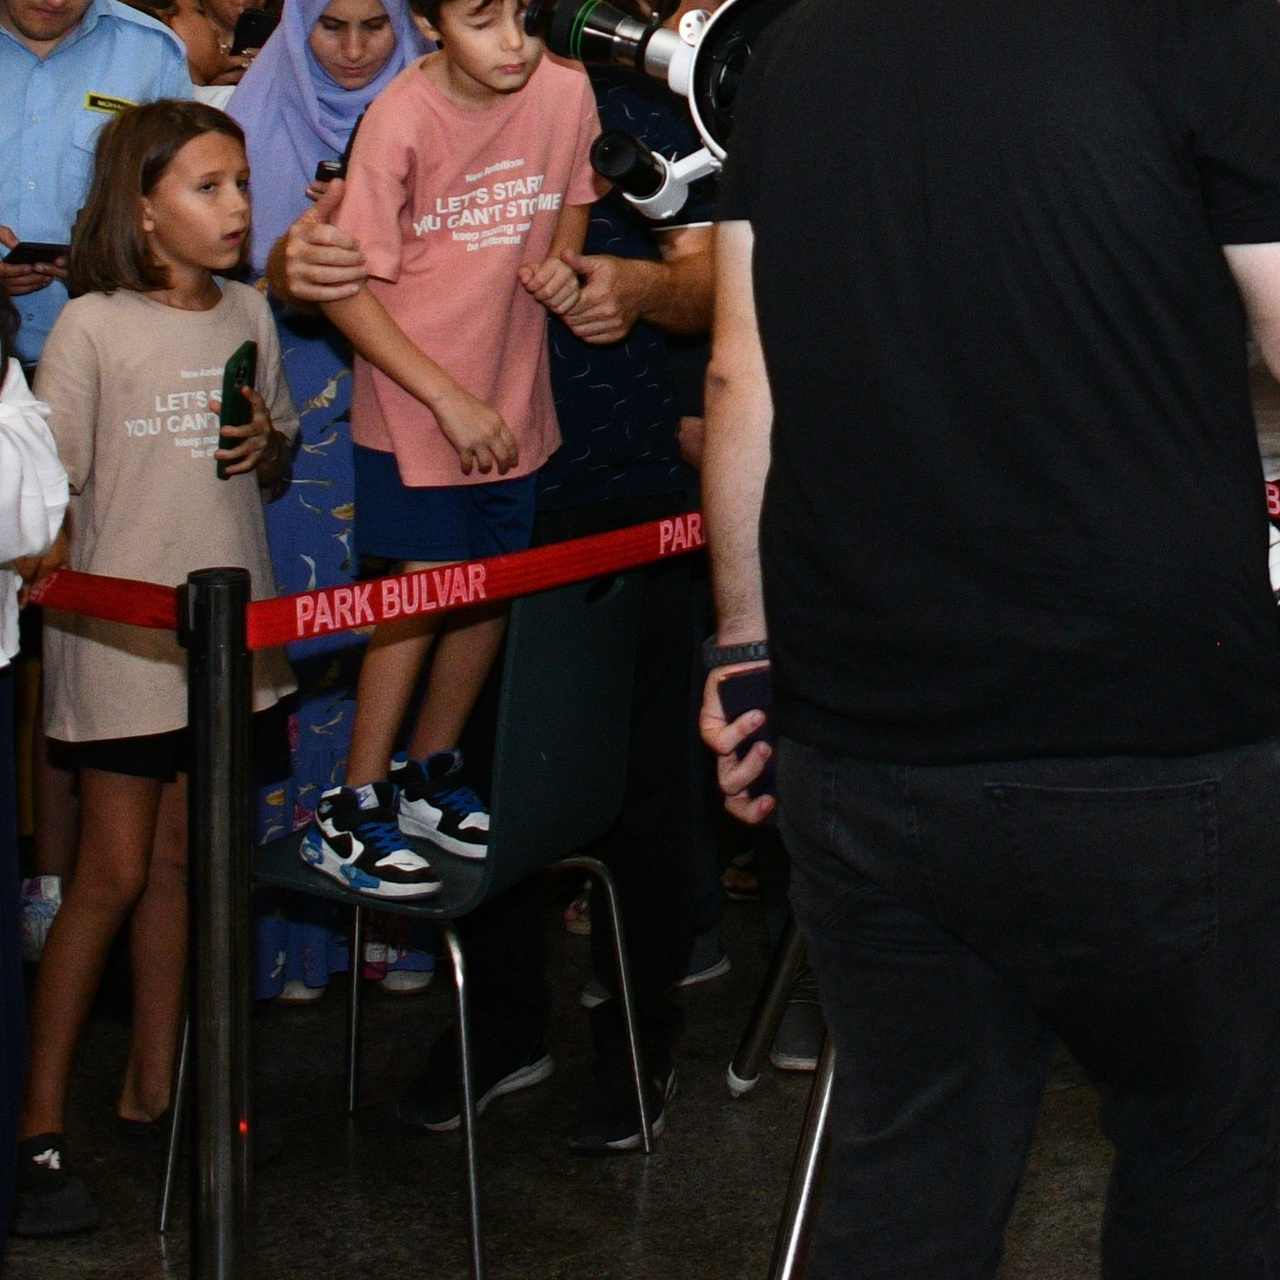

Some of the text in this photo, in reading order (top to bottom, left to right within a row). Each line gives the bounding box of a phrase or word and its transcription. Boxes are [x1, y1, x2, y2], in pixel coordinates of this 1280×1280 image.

[436, 187, 489, 214] LET'S
[447, 204, 503, 229] CAN'T
[452, 230, 479, 242] keep
[467, 242, 479, 251] be
[155, 390, 207, 412] LET'S
[125, 417, 161, 437] YOU
[659, 513, 706, 555] PAR
[296, 563, 487, 636] PARK BULVAR
